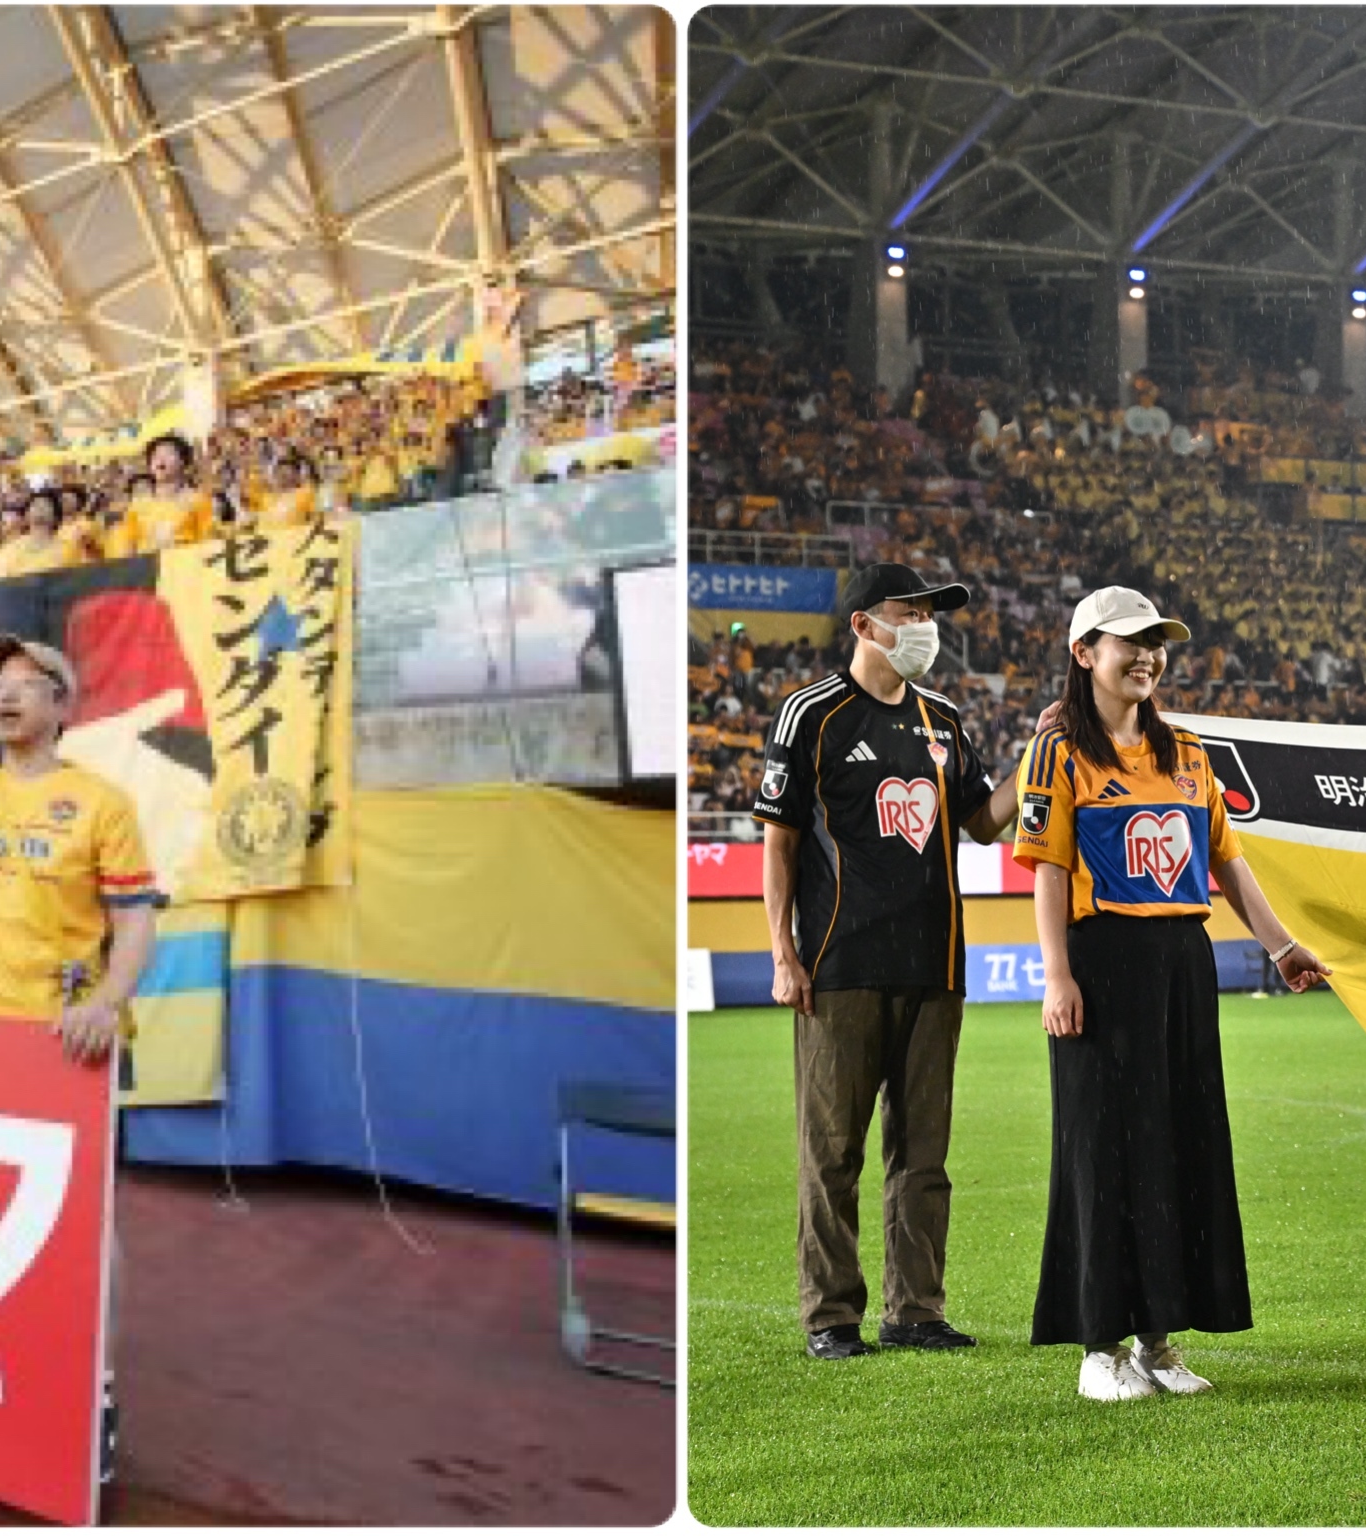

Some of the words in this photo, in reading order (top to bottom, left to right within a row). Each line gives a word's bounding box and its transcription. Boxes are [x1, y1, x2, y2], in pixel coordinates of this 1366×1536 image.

[204, 524, 283, 773] センダイ
[878, 800, 925, 835] IRIS
[1016, 835, 1049, 848] SENDAI
[1127, 836, 1176, 876] IRIS
[984, 952, 1017, 980] 77
